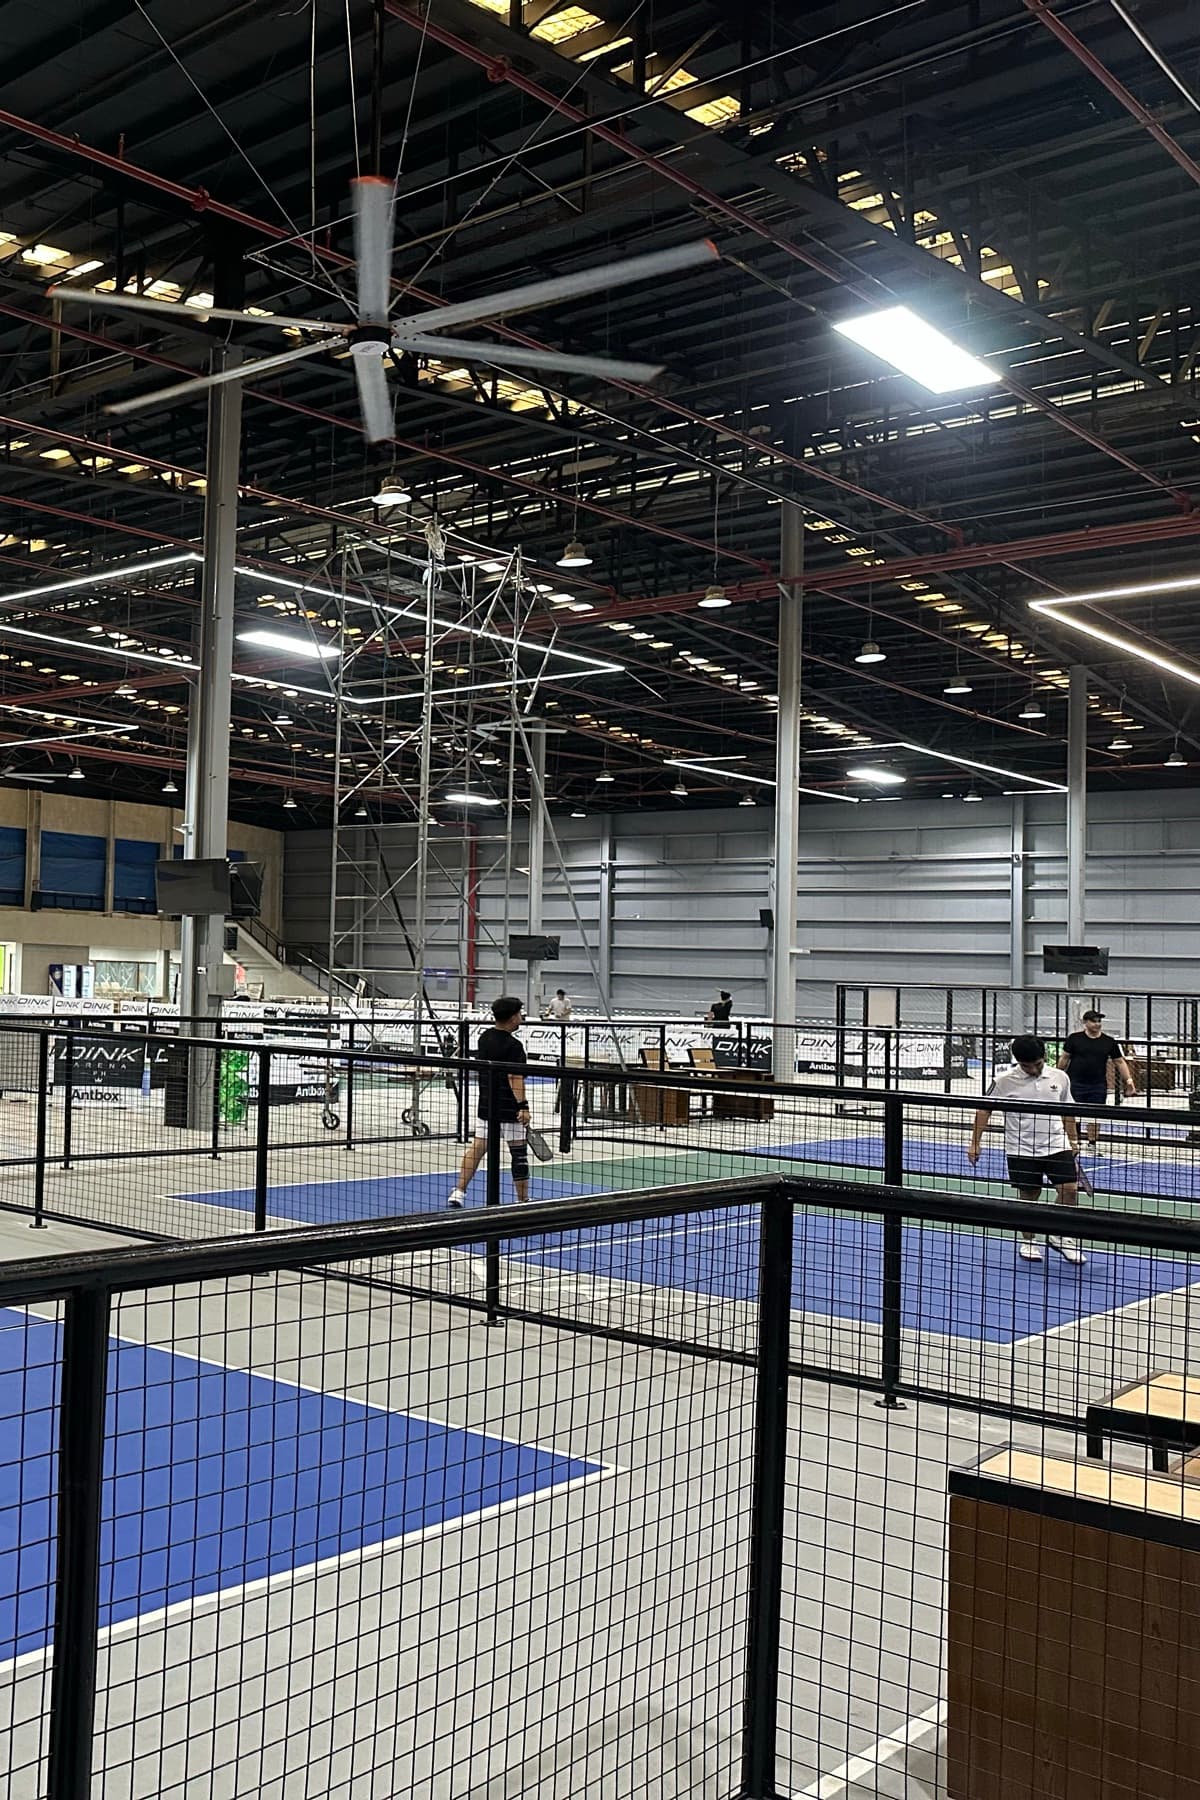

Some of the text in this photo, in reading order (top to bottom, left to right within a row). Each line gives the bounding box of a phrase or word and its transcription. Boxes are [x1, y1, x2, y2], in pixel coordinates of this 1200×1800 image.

[17, 999, 50, 1007] DINK
[56, 1000, 81, 1009] DINK
[83, 1001, 111, 1010] DINK
[122, 1004, 145, 1012] DINK
[150, 1005, 179, 1015] DINK
[809, 1063, 836, 1072] Antbo
[71, 1089, 119, 1102] Antbox
